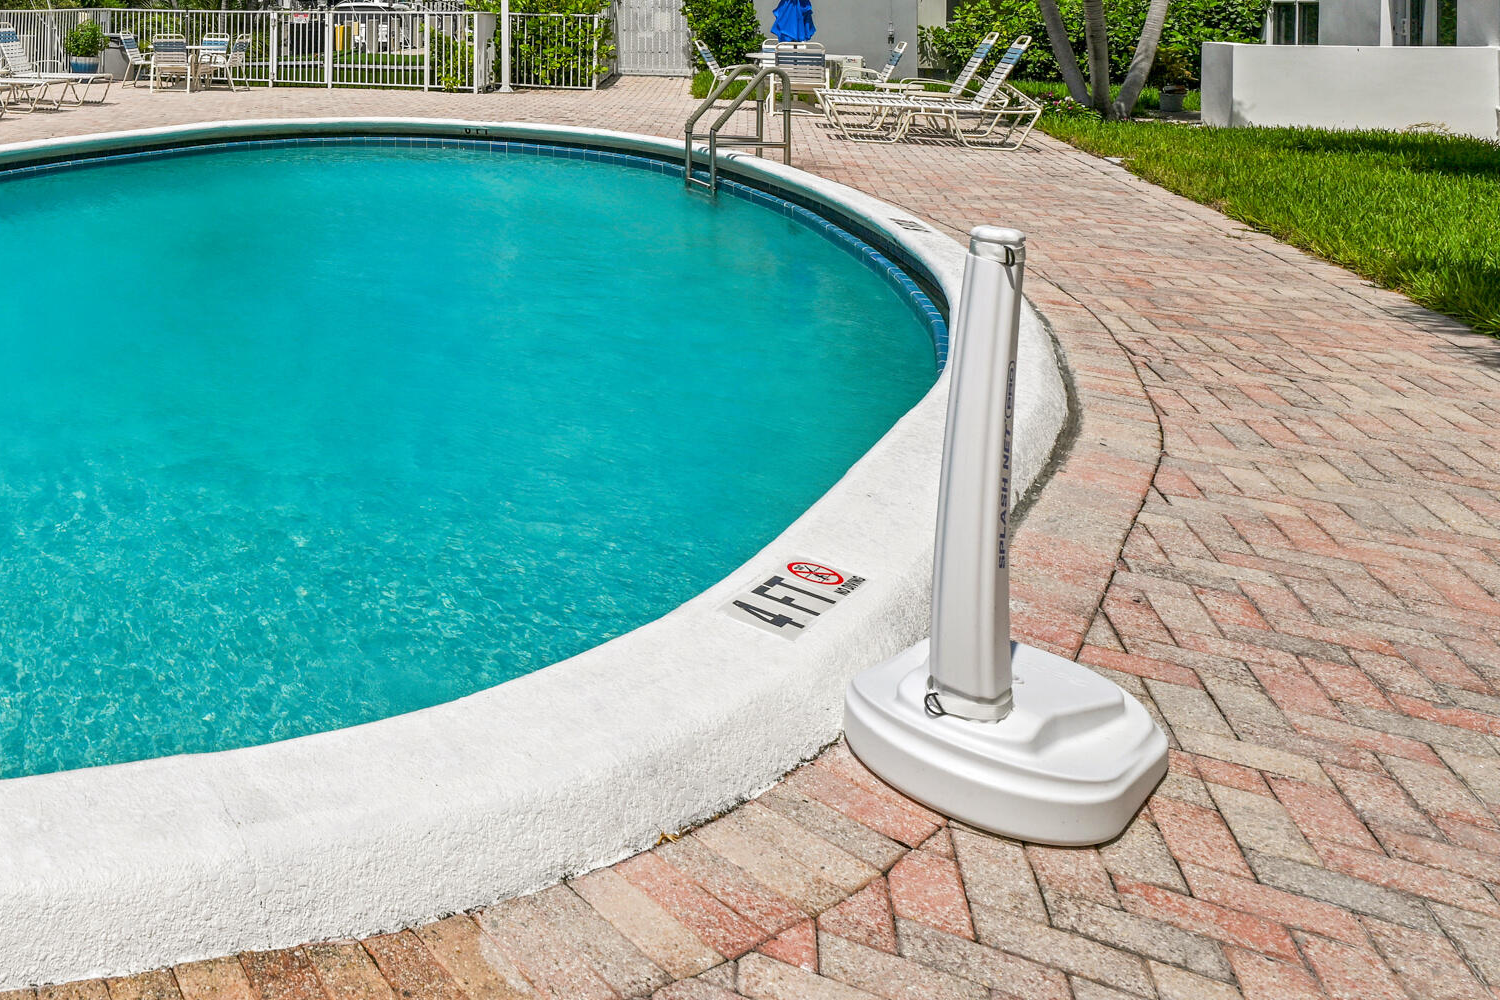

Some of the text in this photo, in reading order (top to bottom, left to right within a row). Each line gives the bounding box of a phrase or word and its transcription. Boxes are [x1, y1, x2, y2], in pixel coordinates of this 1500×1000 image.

[1002, 423, 1011, 470] NET
[998, 477, 1008, 569] SPLASH
[732, 575, 837, 629] 4FT
